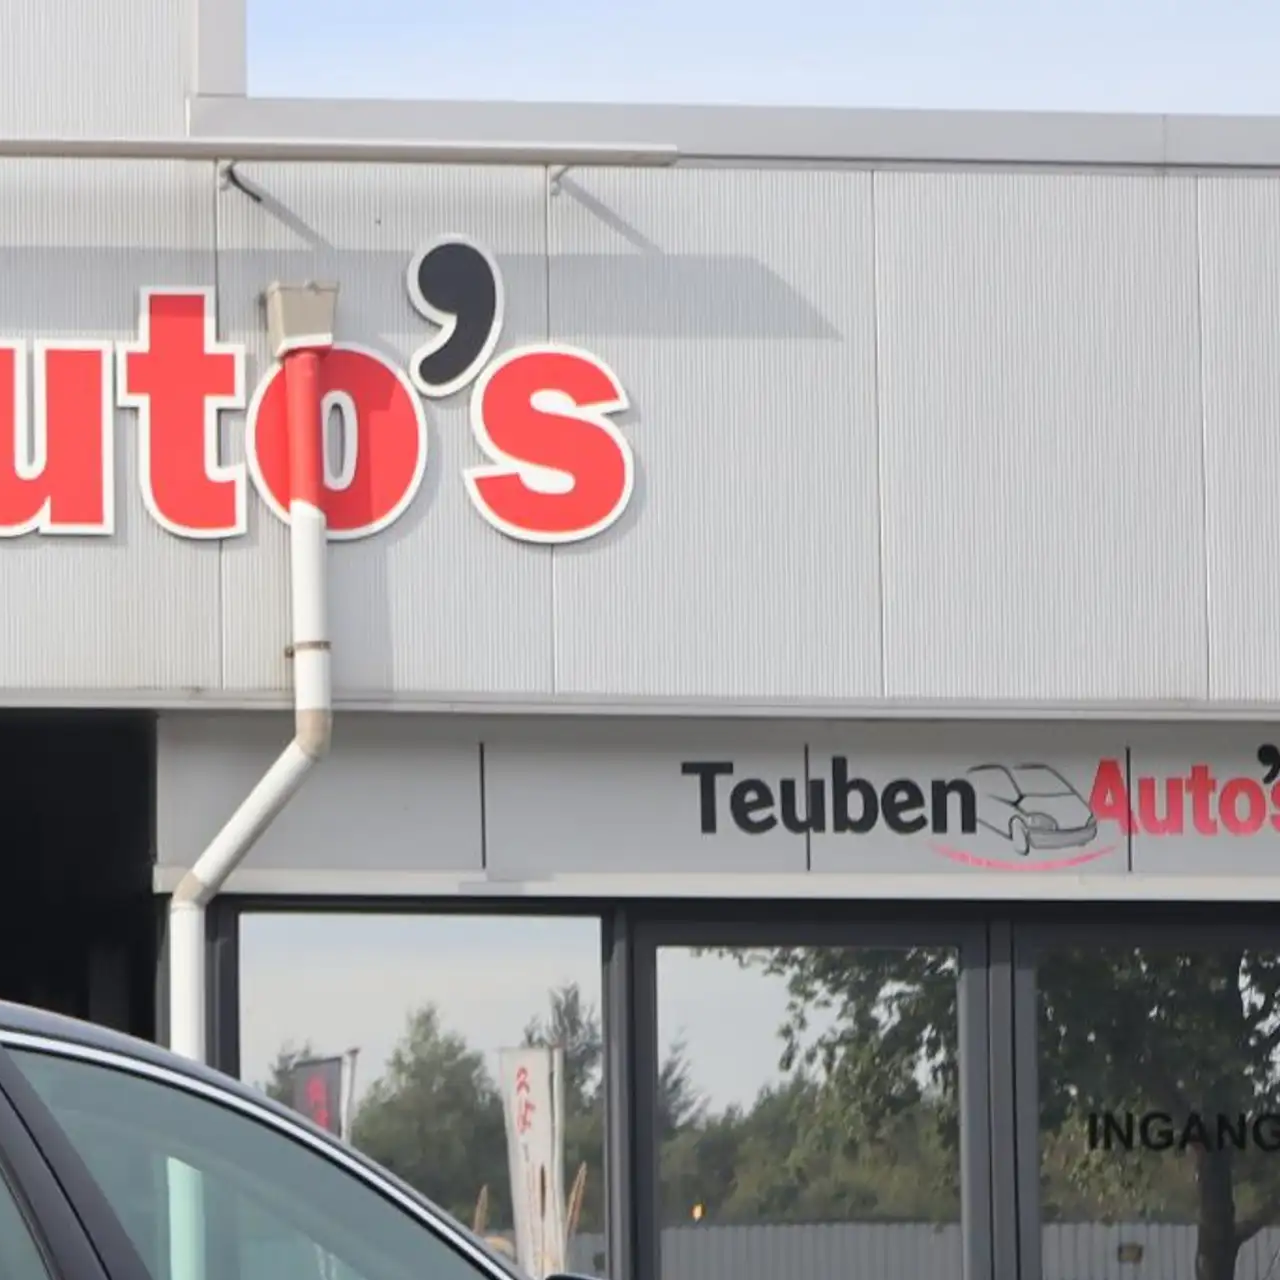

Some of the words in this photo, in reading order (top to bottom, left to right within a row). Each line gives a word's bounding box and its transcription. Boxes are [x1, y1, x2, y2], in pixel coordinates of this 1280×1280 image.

[680, 756, 978, 835] Teuben
[1089, 743, 1280, 838] Auto'
[1087, 1111, 1280, 1152] INGANG
